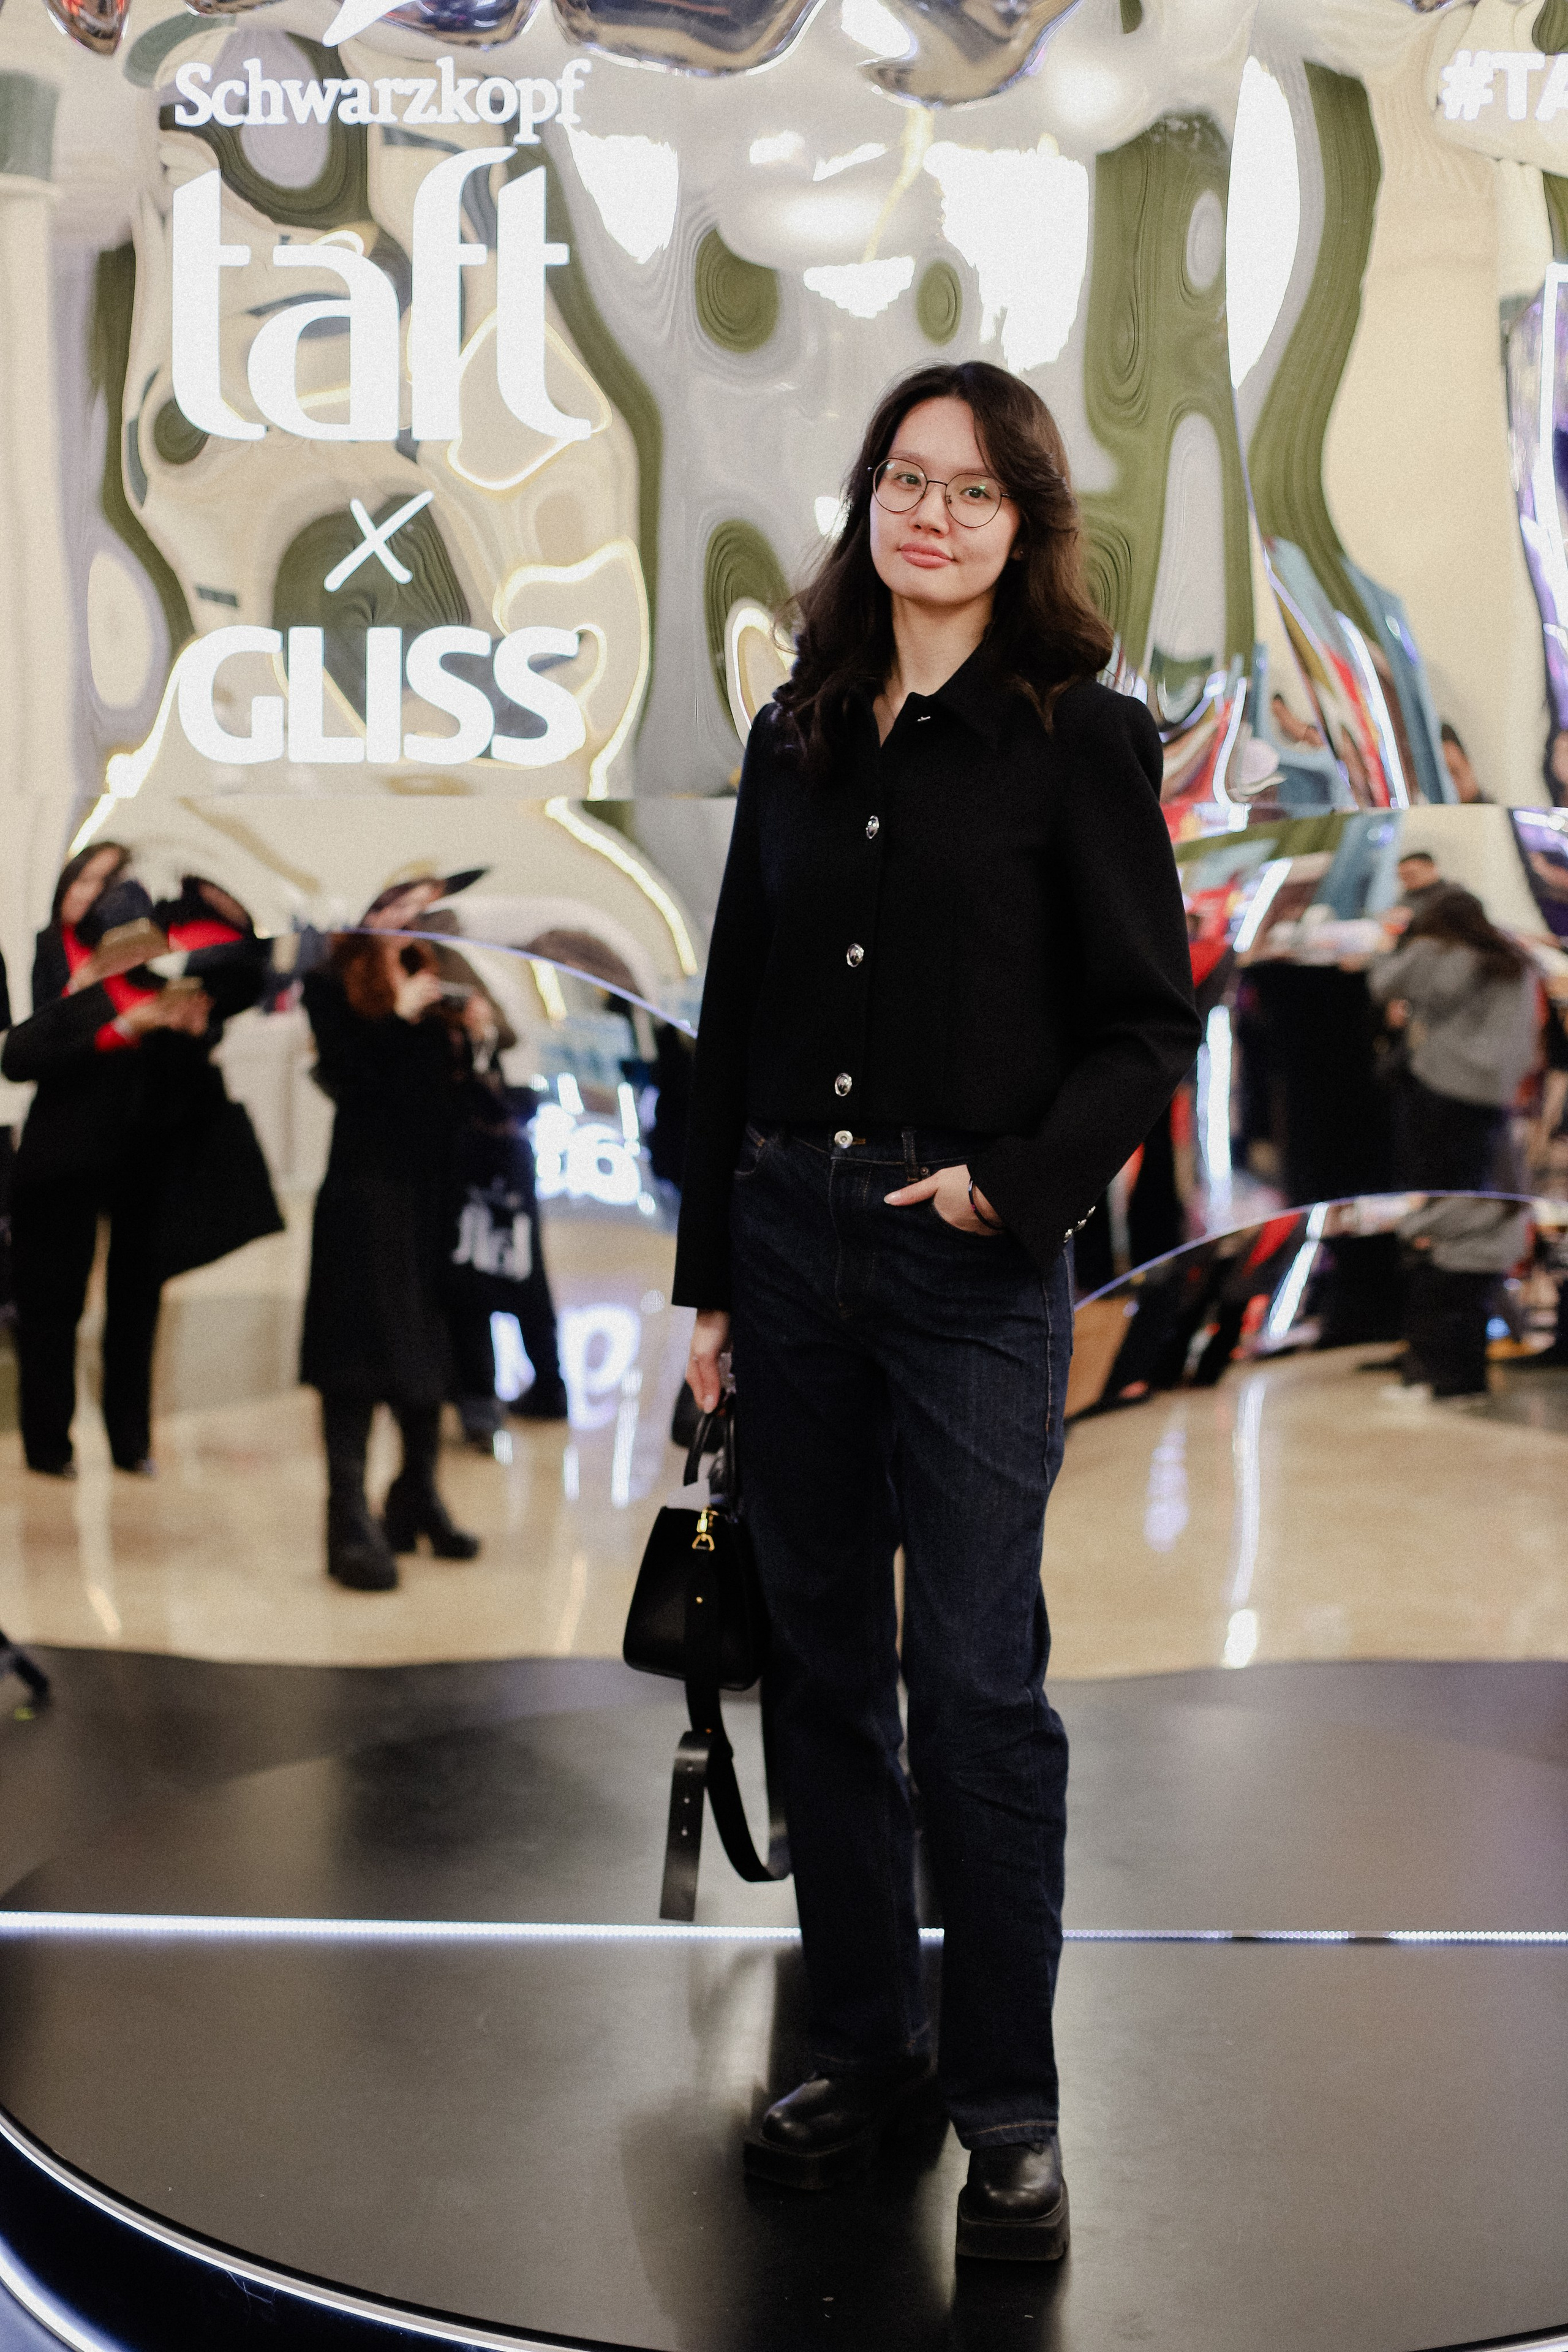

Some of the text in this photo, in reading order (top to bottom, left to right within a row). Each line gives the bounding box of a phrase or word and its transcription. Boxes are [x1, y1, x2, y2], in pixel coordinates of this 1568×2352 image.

[174, 56, 591, 145] Schwarzkopf
[172, 146, 592, 441] taft
[178, 624, 587, 764] GLISS
